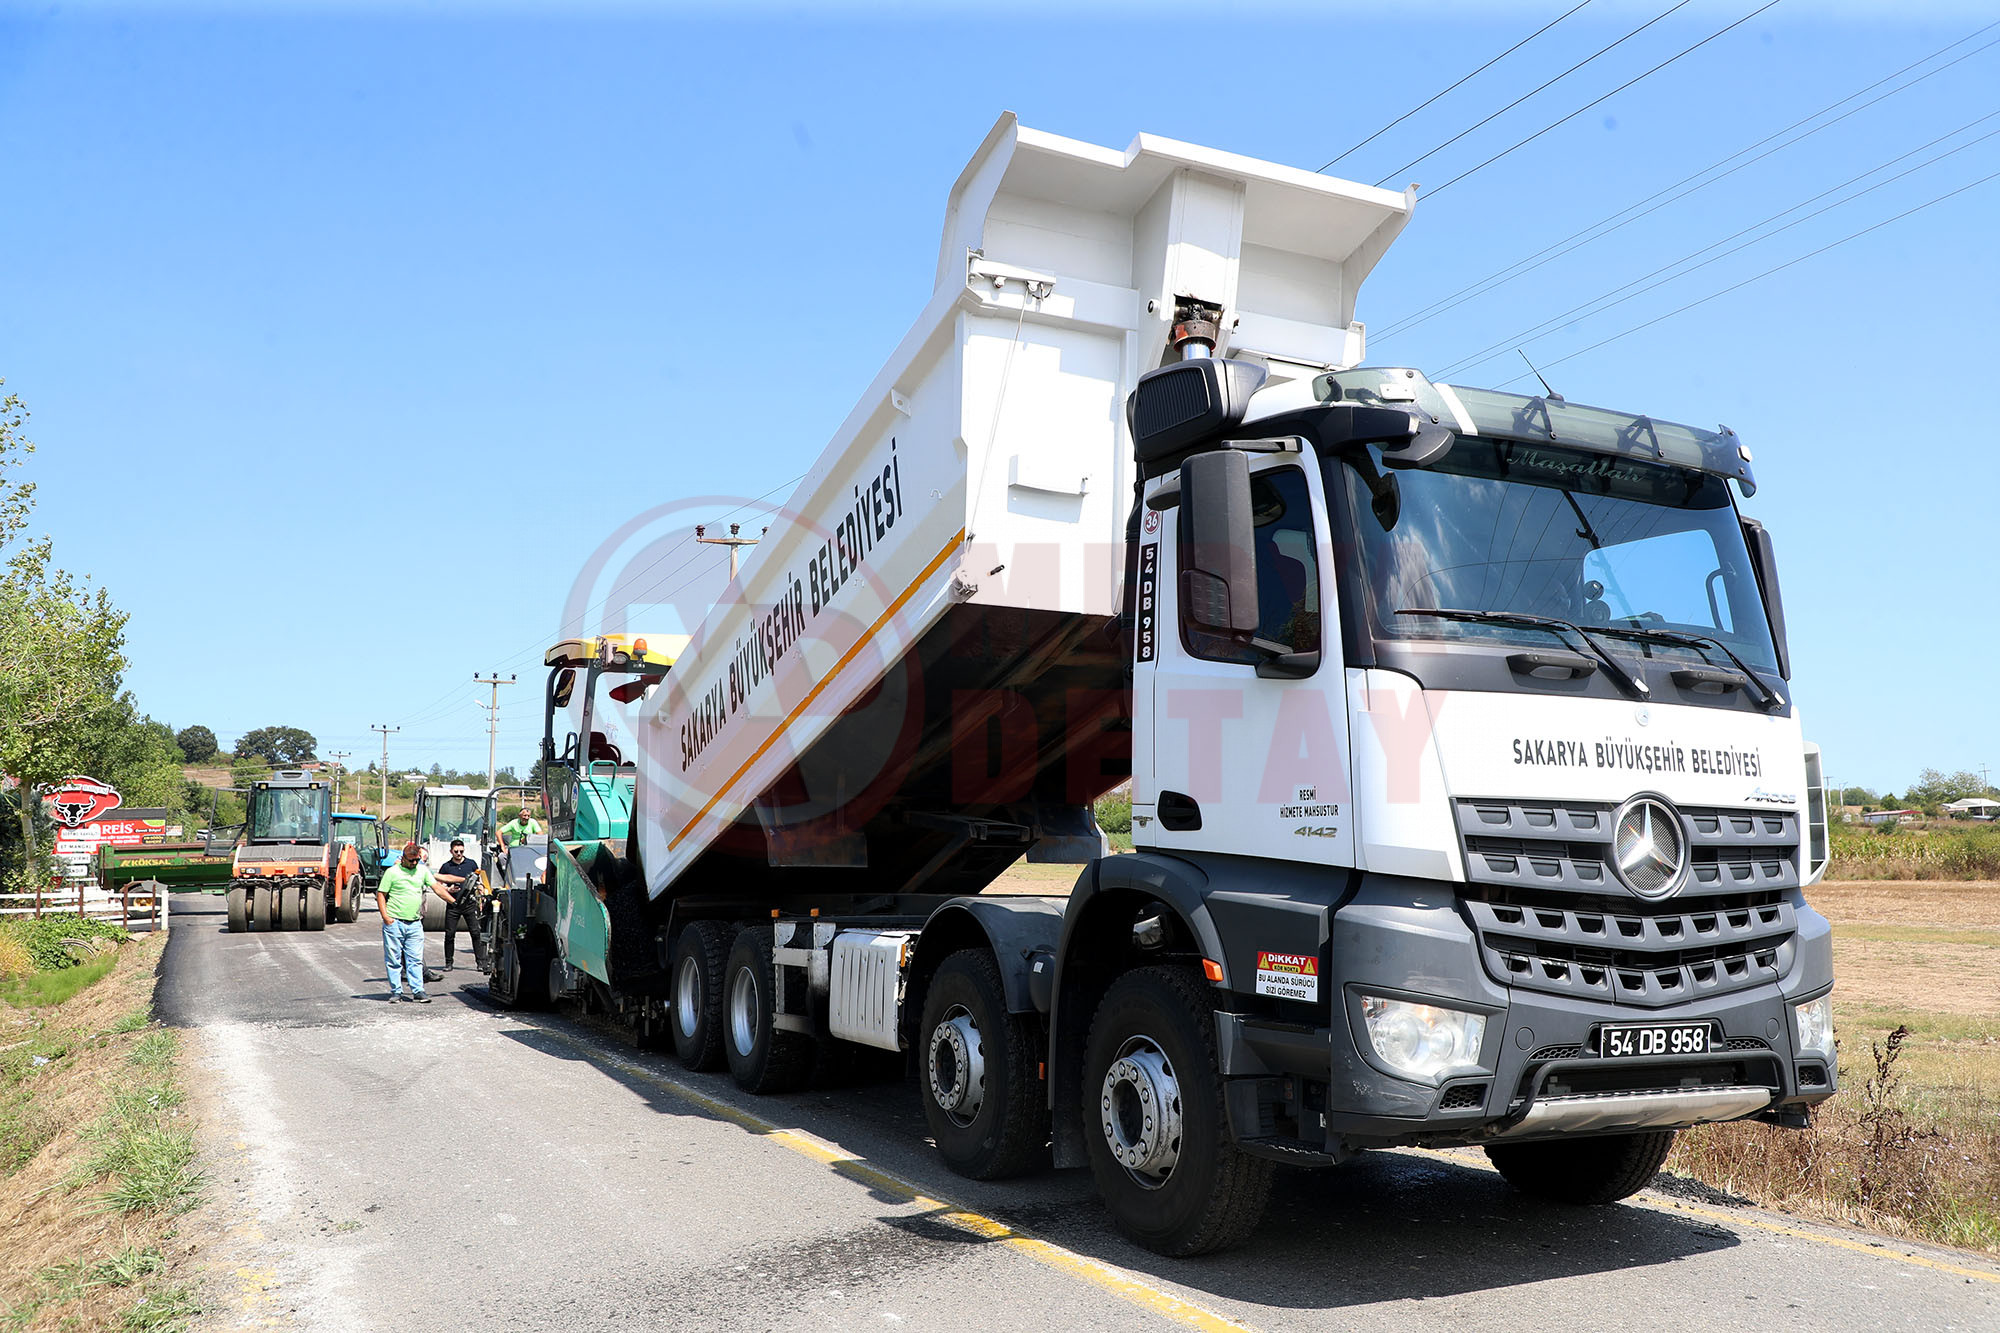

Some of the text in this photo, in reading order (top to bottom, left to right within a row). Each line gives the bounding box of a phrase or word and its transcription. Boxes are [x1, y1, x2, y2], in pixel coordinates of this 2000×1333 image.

[1146, 513, 1158, 526] 36
[681, 436, 902, 773] SAKARYA BÜYÜKŞEHİR BELEDİYESİ
[1513, 736, 1762, 778] SAKARYA BÜYÜKŞEHİR BELEDİYESİ
[1279, 803, 1303, 818] HİZMETE
[102, 822, 134, 835] REİS
[1294, 826, 1338, 838] 4142
[1258, 973, 1316, 989] BU ALANDA SÜRÜCÜ
[1610, 1027, 1705, 1056] 54 DB 958
